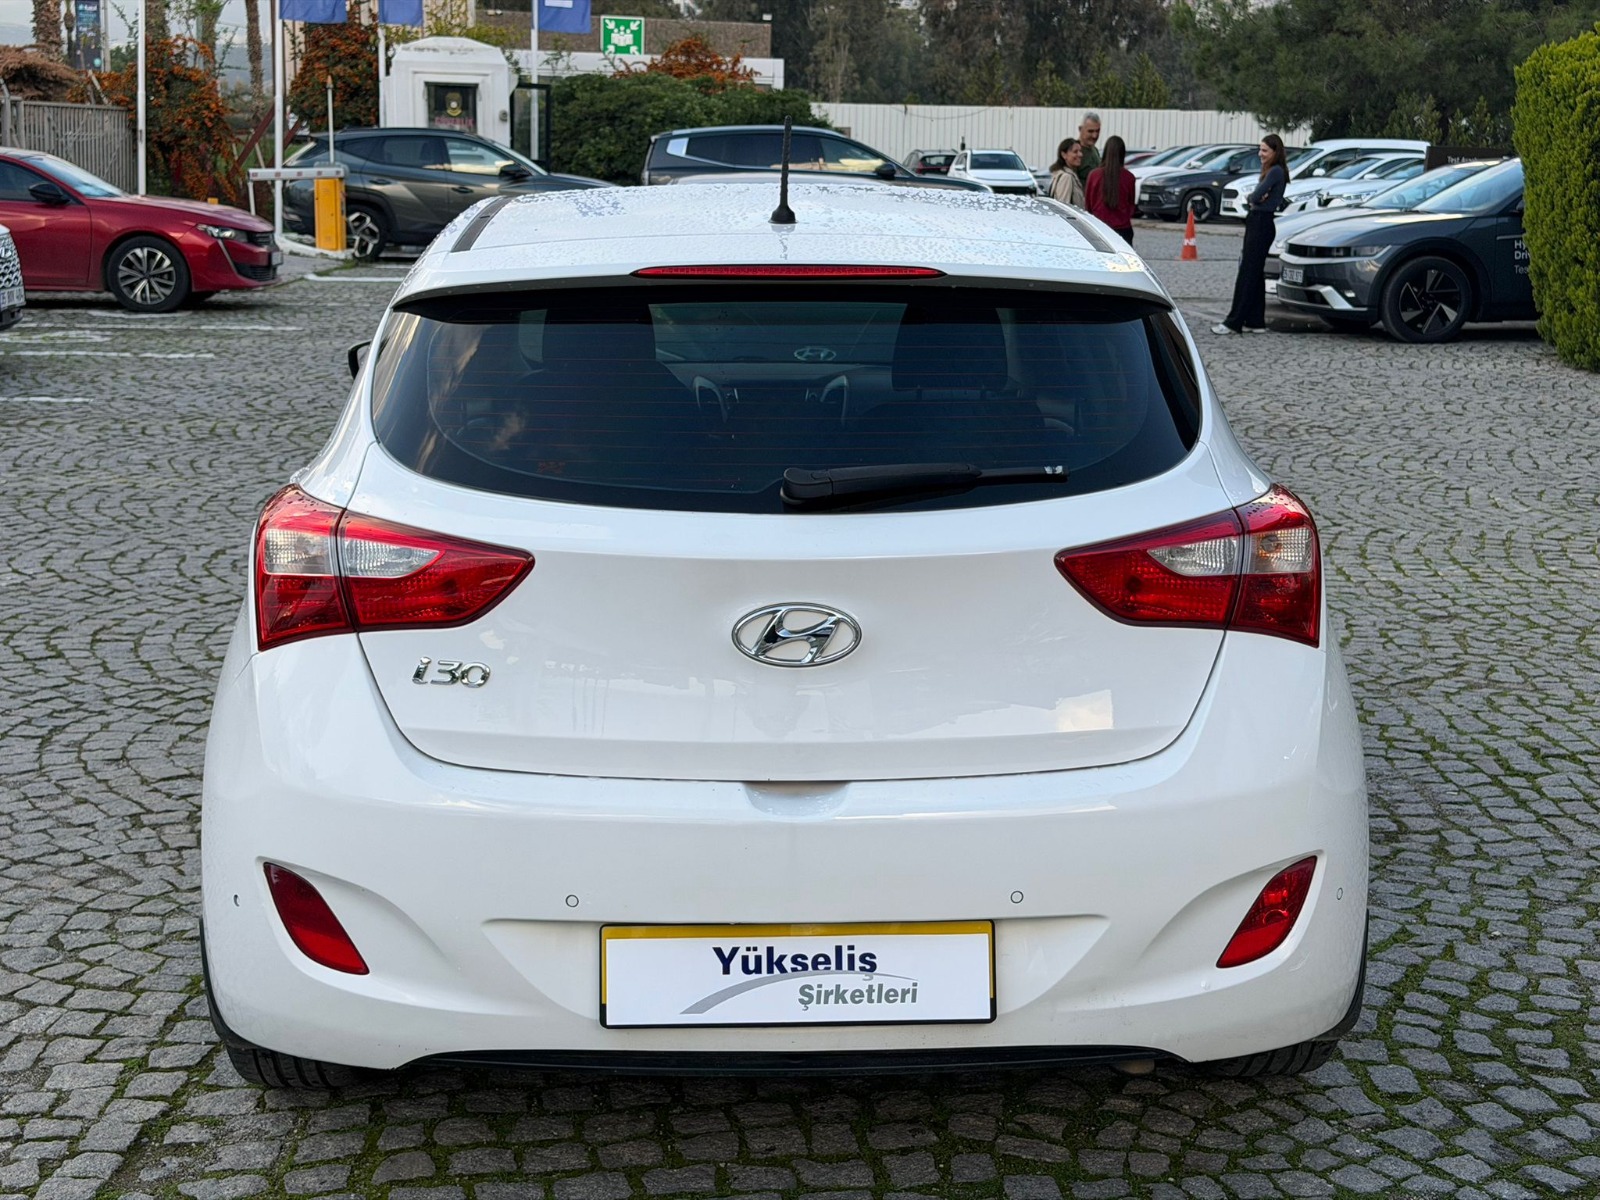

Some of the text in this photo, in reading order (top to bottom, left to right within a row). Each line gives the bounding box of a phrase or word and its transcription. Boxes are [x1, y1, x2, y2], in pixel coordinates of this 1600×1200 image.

[412, 656, 491, 688] i30
[712, 945, 877, 981] Yükseliş
[798, 982, 918, 1011] Şirketleri
